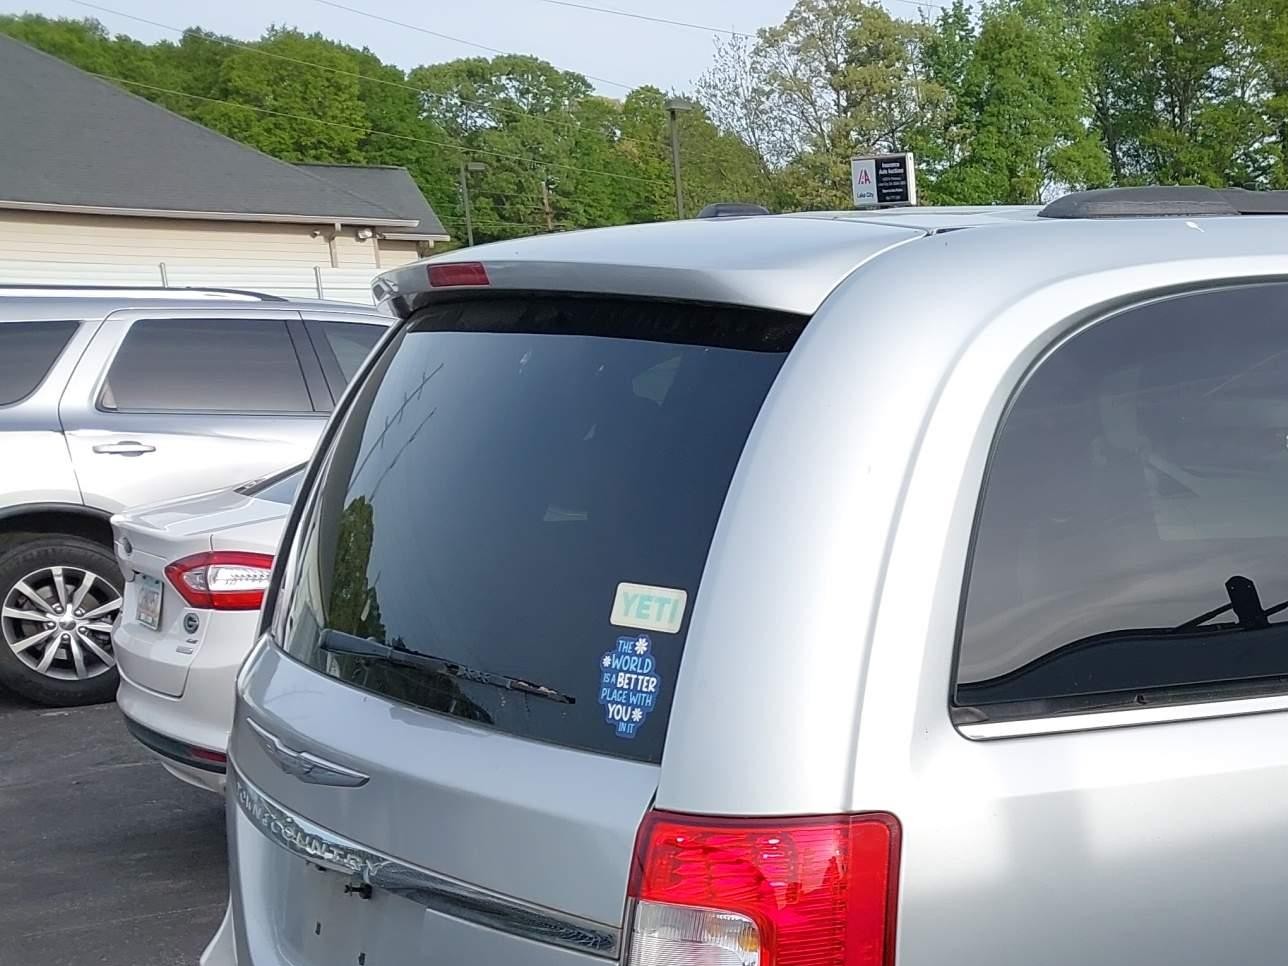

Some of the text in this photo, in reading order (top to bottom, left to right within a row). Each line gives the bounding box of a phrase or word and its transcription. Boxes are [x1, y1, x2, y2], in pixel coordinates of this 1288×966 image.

[621, 591, 680, 624] YETI
[618, 639, 634, 654] THE
[611, 654, 652, 674] WORLD
[603, 672, 658, 692] IS A BETTER
[600, 687, 653, 706] PLACE WITH
[607, 702, 632, 721] YOU
[618, 722, 635, 733] IN IT
